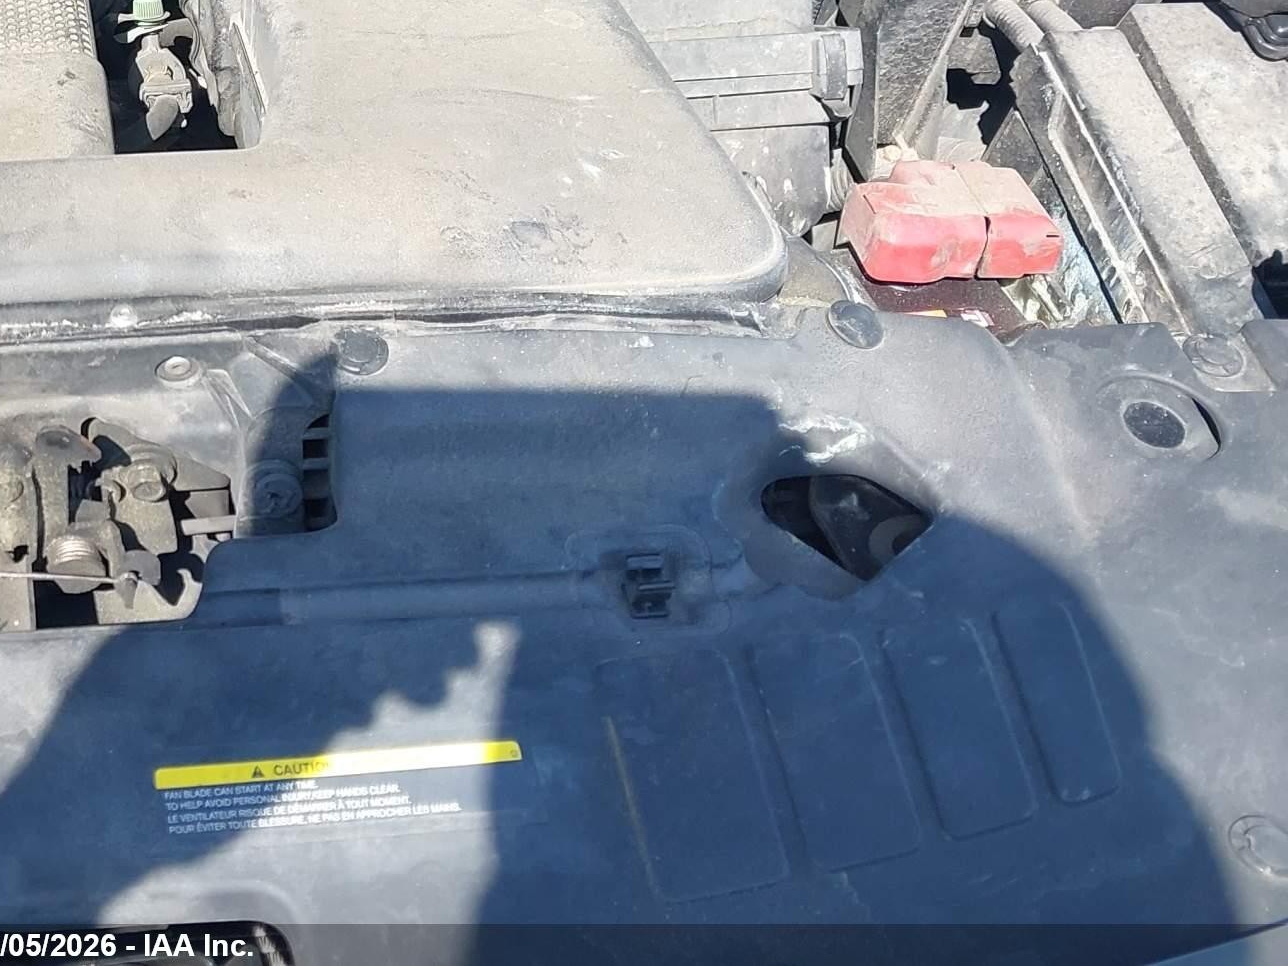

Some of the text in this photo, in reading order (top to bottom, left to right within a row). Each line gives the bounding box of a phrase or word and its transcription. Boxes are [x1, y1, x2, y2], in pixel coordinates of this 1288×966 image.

[273, 761, 330, 777] CAUTIO
[165, 791, 182, 800] FAN
[184, 789, 212, 799] BLADE
[214, 788, 234, 797] CAN
[235, 785, 261, 795] START
[263, 784, 274, 792] AT
[276, 782, 294, 792] ANY
[166, 802, 178, 811] TO
[180, 800, 203, 810] HELP
[205, 798, 232, 808] AVOID
[233, 795, 281, 806] PERSONAL
[336, 786, 368, 797] HANDS
[167, 814, 179, 824] LE
[180, 810, 237, 822] VENTILATEUR
[238, 807, 272, 818] RISQUE
[274, 805, 286, 815] DE
[288, 799, 336, 814] DÉMARRER
[346, 797, 369, 809] TOUT
[168, 824, 196, 835] POUR
[197, 821, 227, 833] ÉVITER
[228, 819, 257, 830] TOUTE
[308, 812, 321, 824] NE
[323, 811, 340, 822] PAS
[342, 809, 354, 821] EN
[355, 805, 411, 819] APPROCHER
[412, 804, 429, 815] LES
